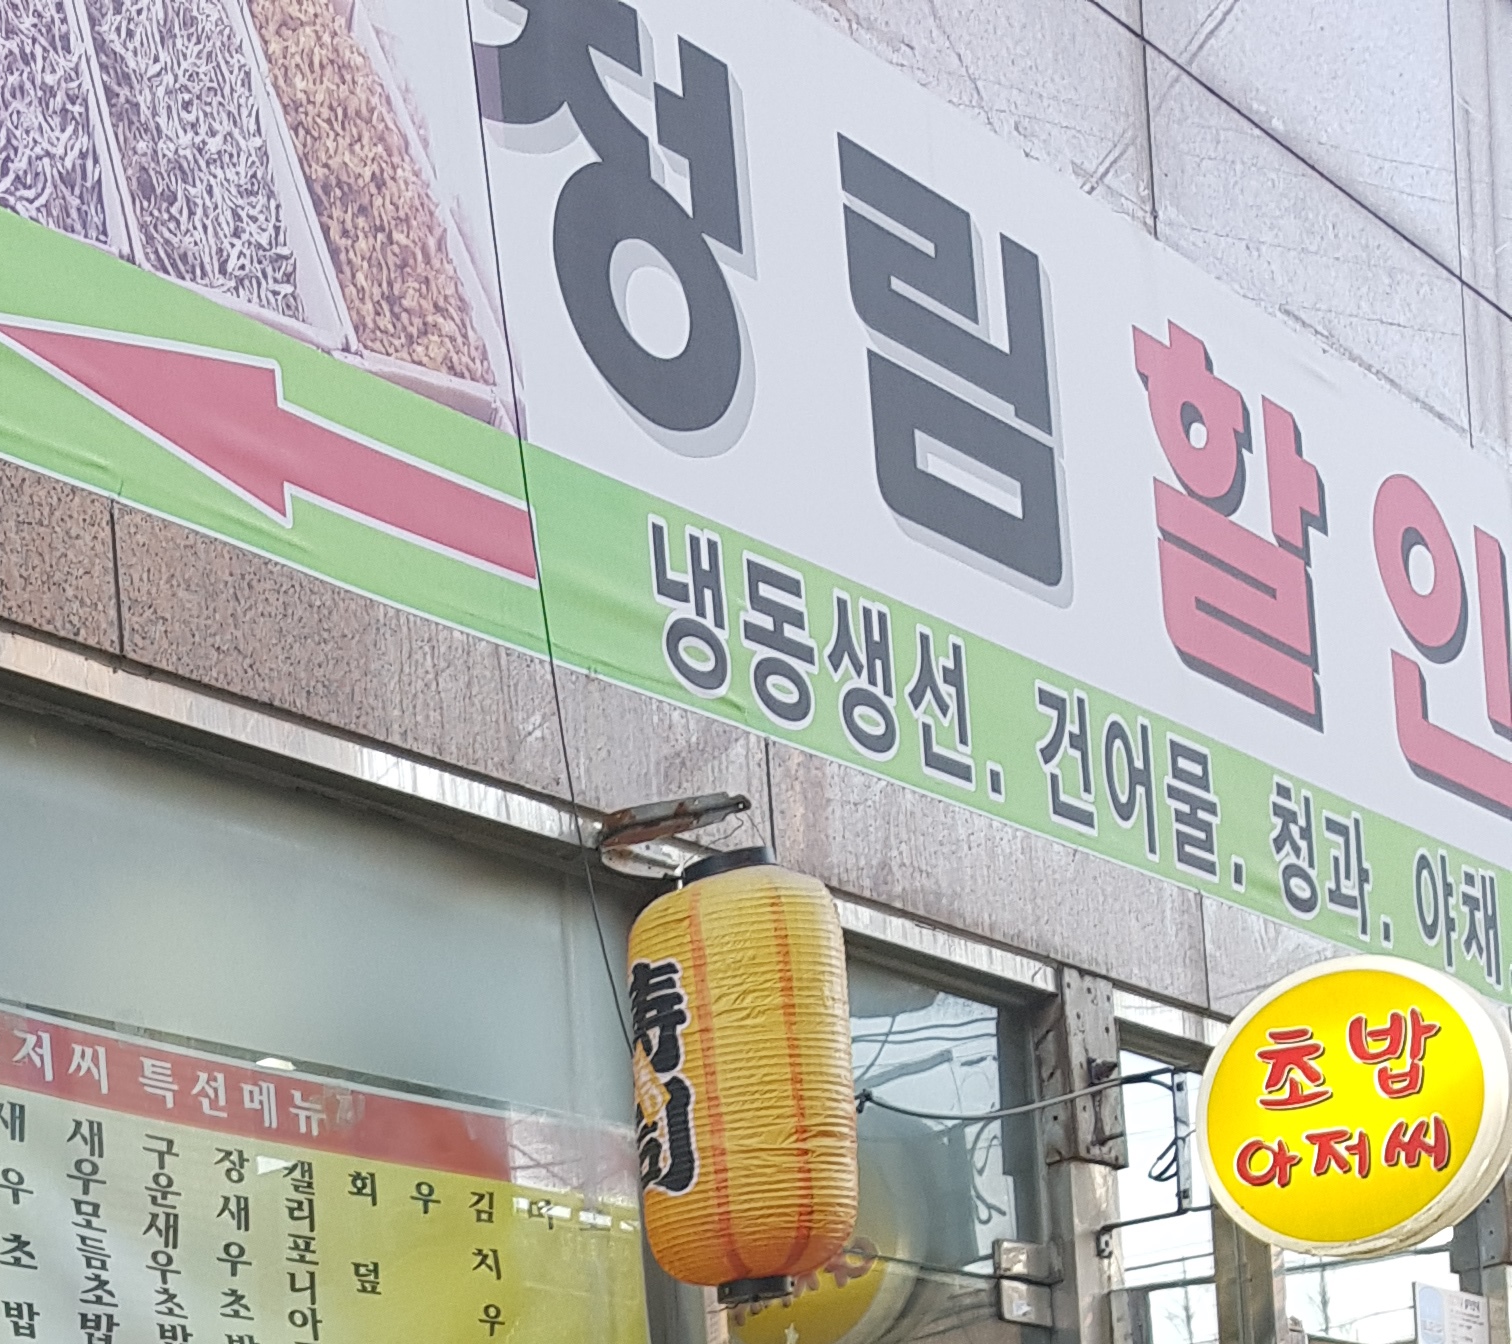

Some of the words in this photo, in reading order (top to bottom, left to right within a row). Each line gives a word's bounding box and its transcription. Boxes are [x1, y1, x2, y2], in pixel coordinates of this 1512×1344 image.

[138, 1056, 327, 1138] 특선메뉴
[1257, 1008, 1441, 1110] 초밥
[1235, 1115, 1452, 1188] 아저씨
